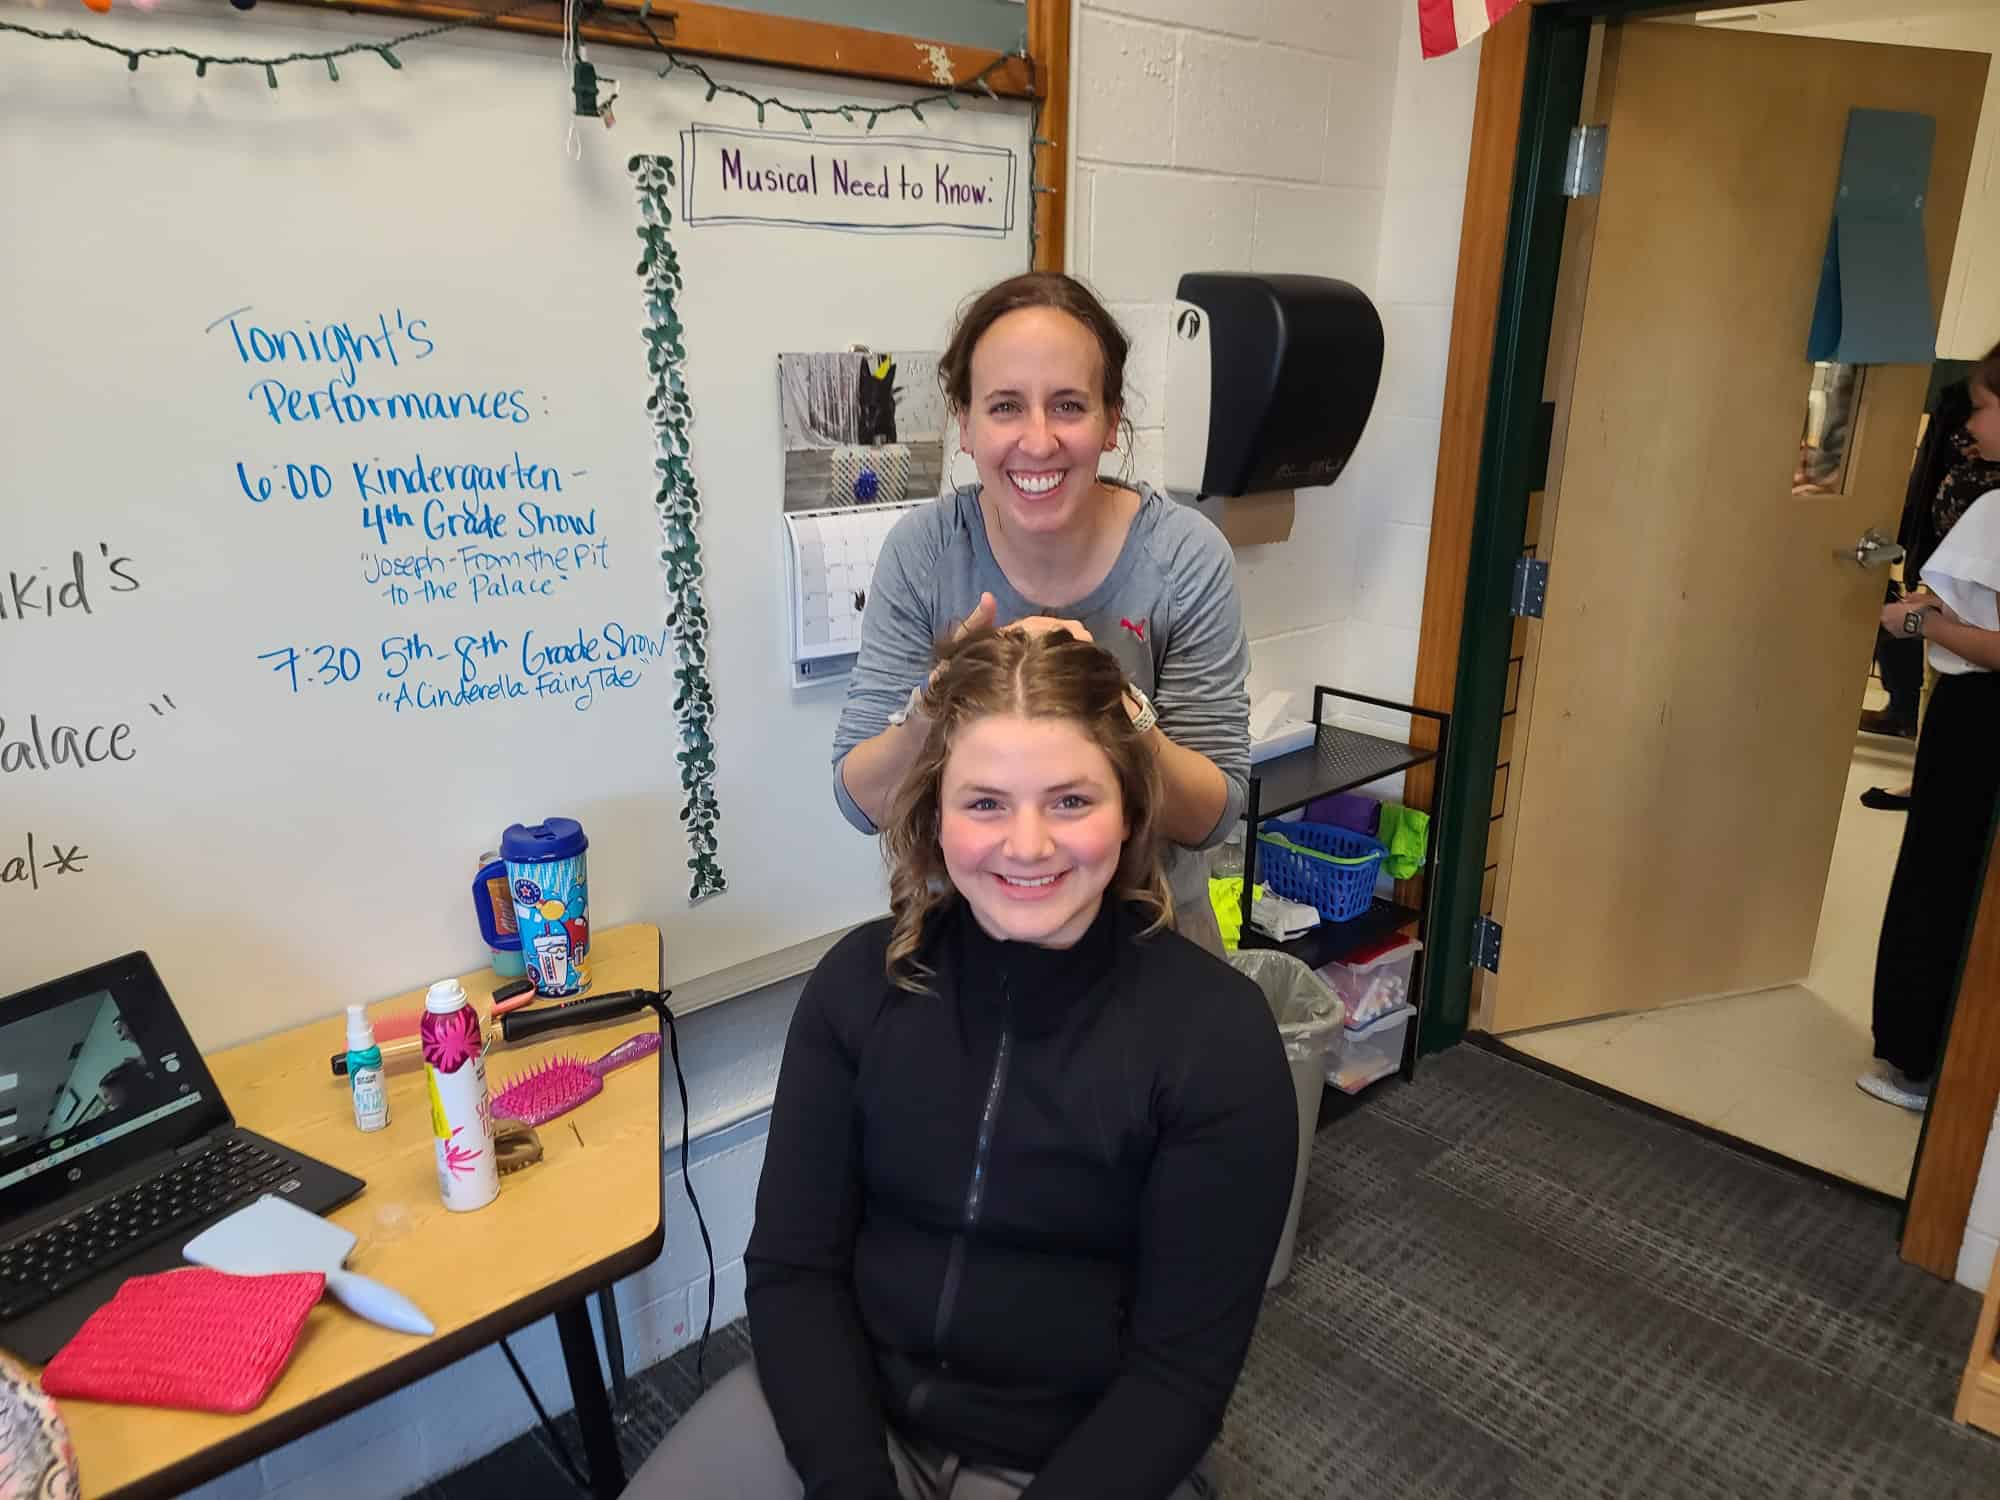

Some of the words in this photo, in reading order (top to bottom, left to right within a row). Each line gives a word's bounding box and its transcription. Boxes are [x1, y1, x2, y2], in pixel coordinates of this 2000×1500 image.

[721, 148, 818, 196] Musical
[832, 158, 890, 200] Need
[899, 164, 924, 201] to
[205, 305, 435, 389] Tonight's
[236, 460, 333, 502] 6:00
[362, 503, 416, 545] 4th
[423, 498, 508, 542] Grade
[517, 501, 597, 539] Show
[523, 544, 569, 573] the
[573, 535, 609, 569] Pit
[381, 583, 409, 606] to
[413, 579, 458, 604] the
[257, 643, 362, 693] 7:30
[521, 627, 601, 677] Grade
[603, 622, 669, 661] Show
[416, 674, 530, 709] Cinderella
[535, 671, 592, 712] Fairy
[0, 693, 177, 773] alace"
